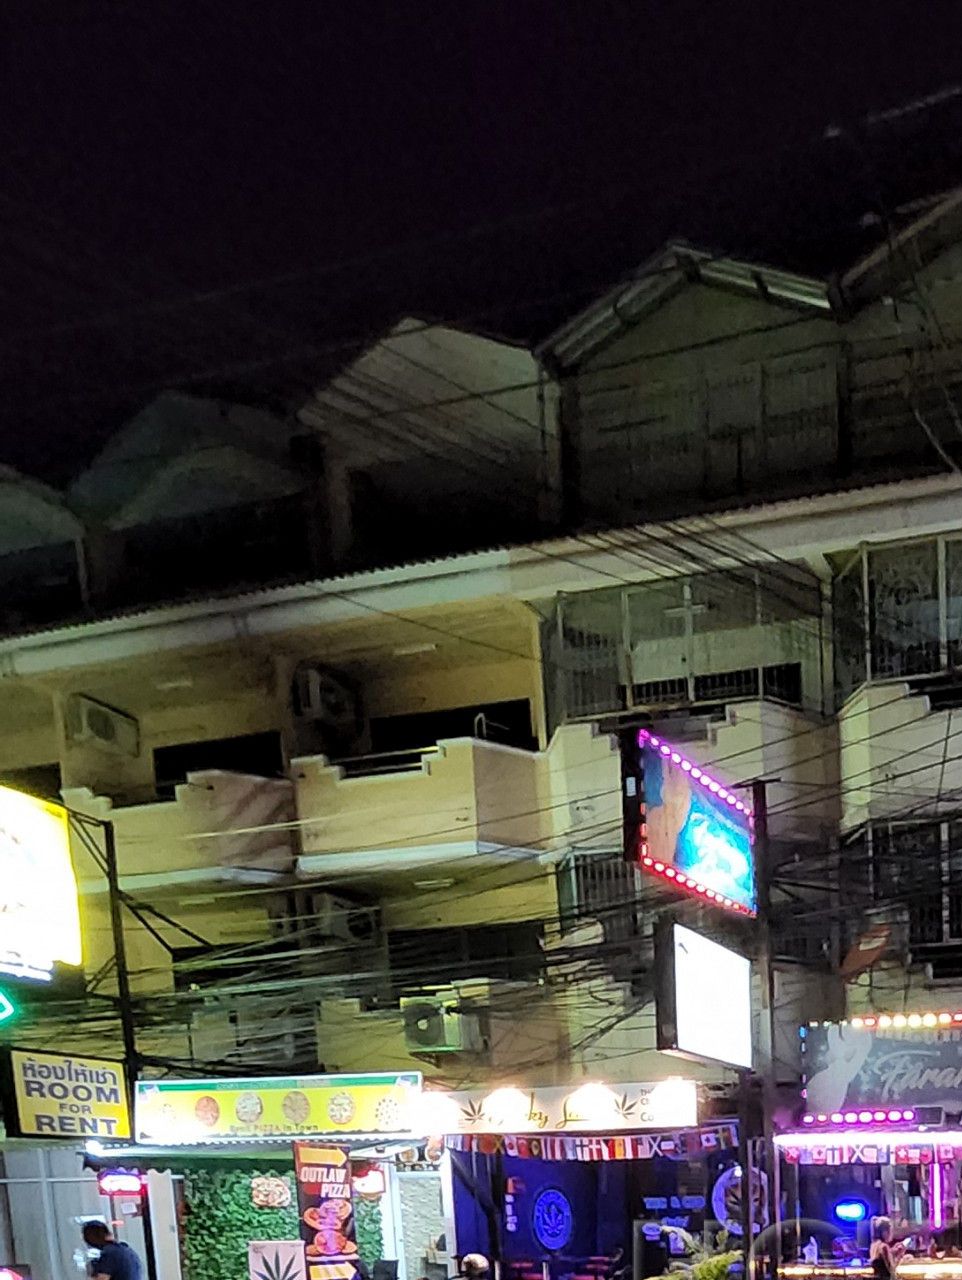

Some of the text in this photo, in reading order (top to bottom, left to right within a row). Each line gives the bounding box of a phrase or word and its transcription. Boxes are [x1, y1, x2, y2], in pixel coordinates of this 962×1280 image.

[22, 1057, 118, 1086] ห้องให้เช่า
[24, 1080, 120, 1104] ROOM
[59, 1103, 92, 1114] FOR
[35, 1114, 117, 1136] RENT
[254, 1124, 281, 1133] PIZZA
[295, 1123, 319, 1132] Town
[300, 1167, 346, 1184] OUTLAW
[320, 1183, 350, 1198] PIZZA
